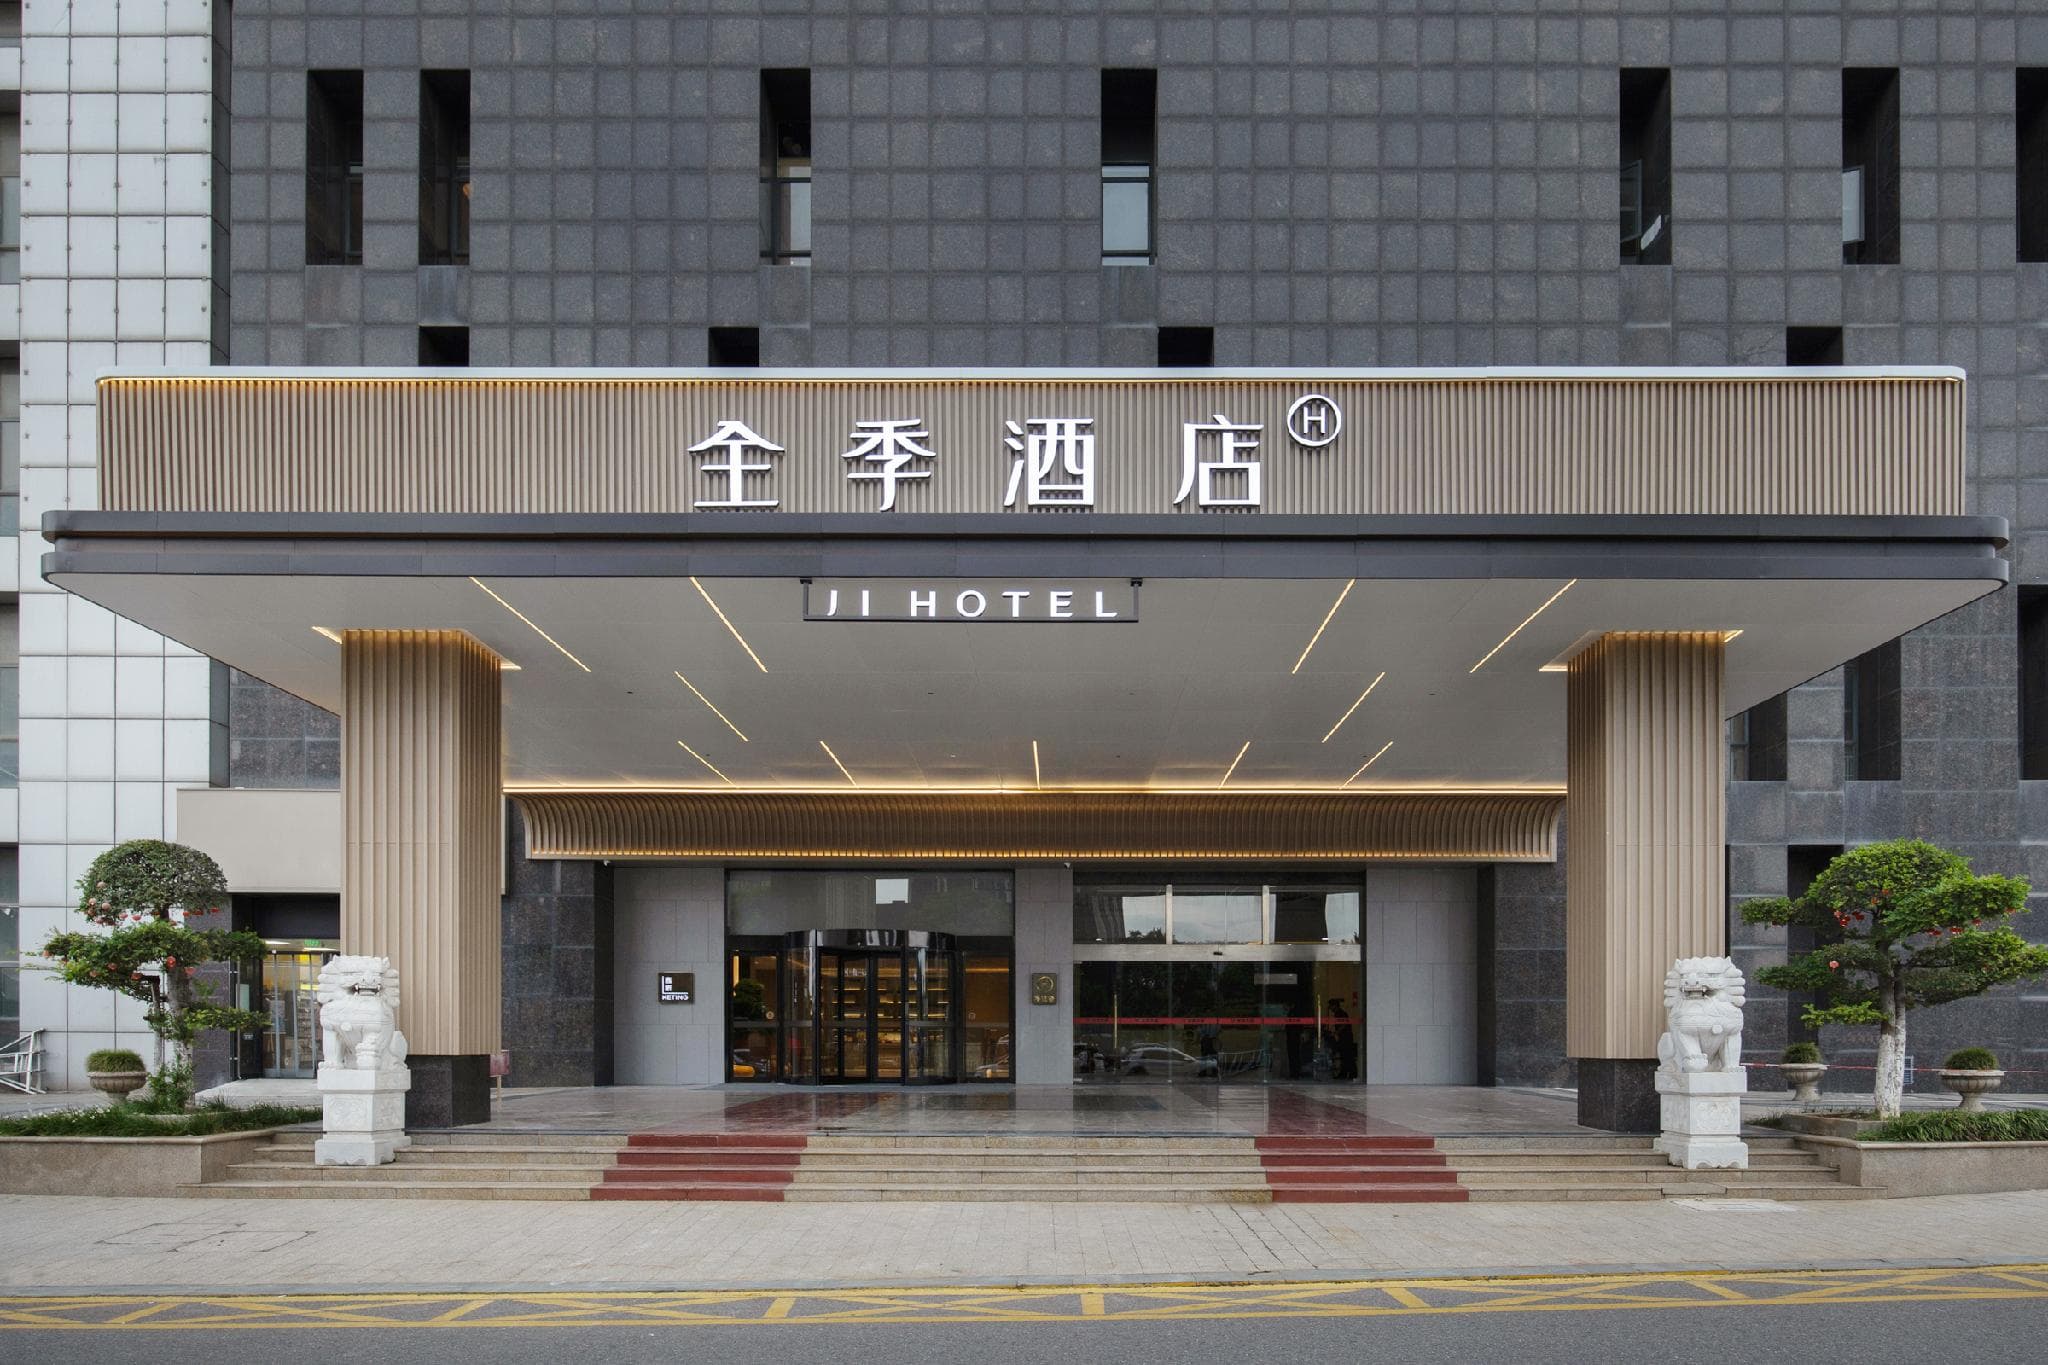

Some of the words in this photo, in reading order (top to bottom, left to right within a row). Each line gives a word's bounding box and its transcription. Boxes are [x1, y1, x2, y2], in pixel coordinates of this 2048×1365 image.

[687, 414, 1264, 511] 全季酒店
[827, 589, 869, 616] JI
[910, 589, 1118, 618] HOTEL
